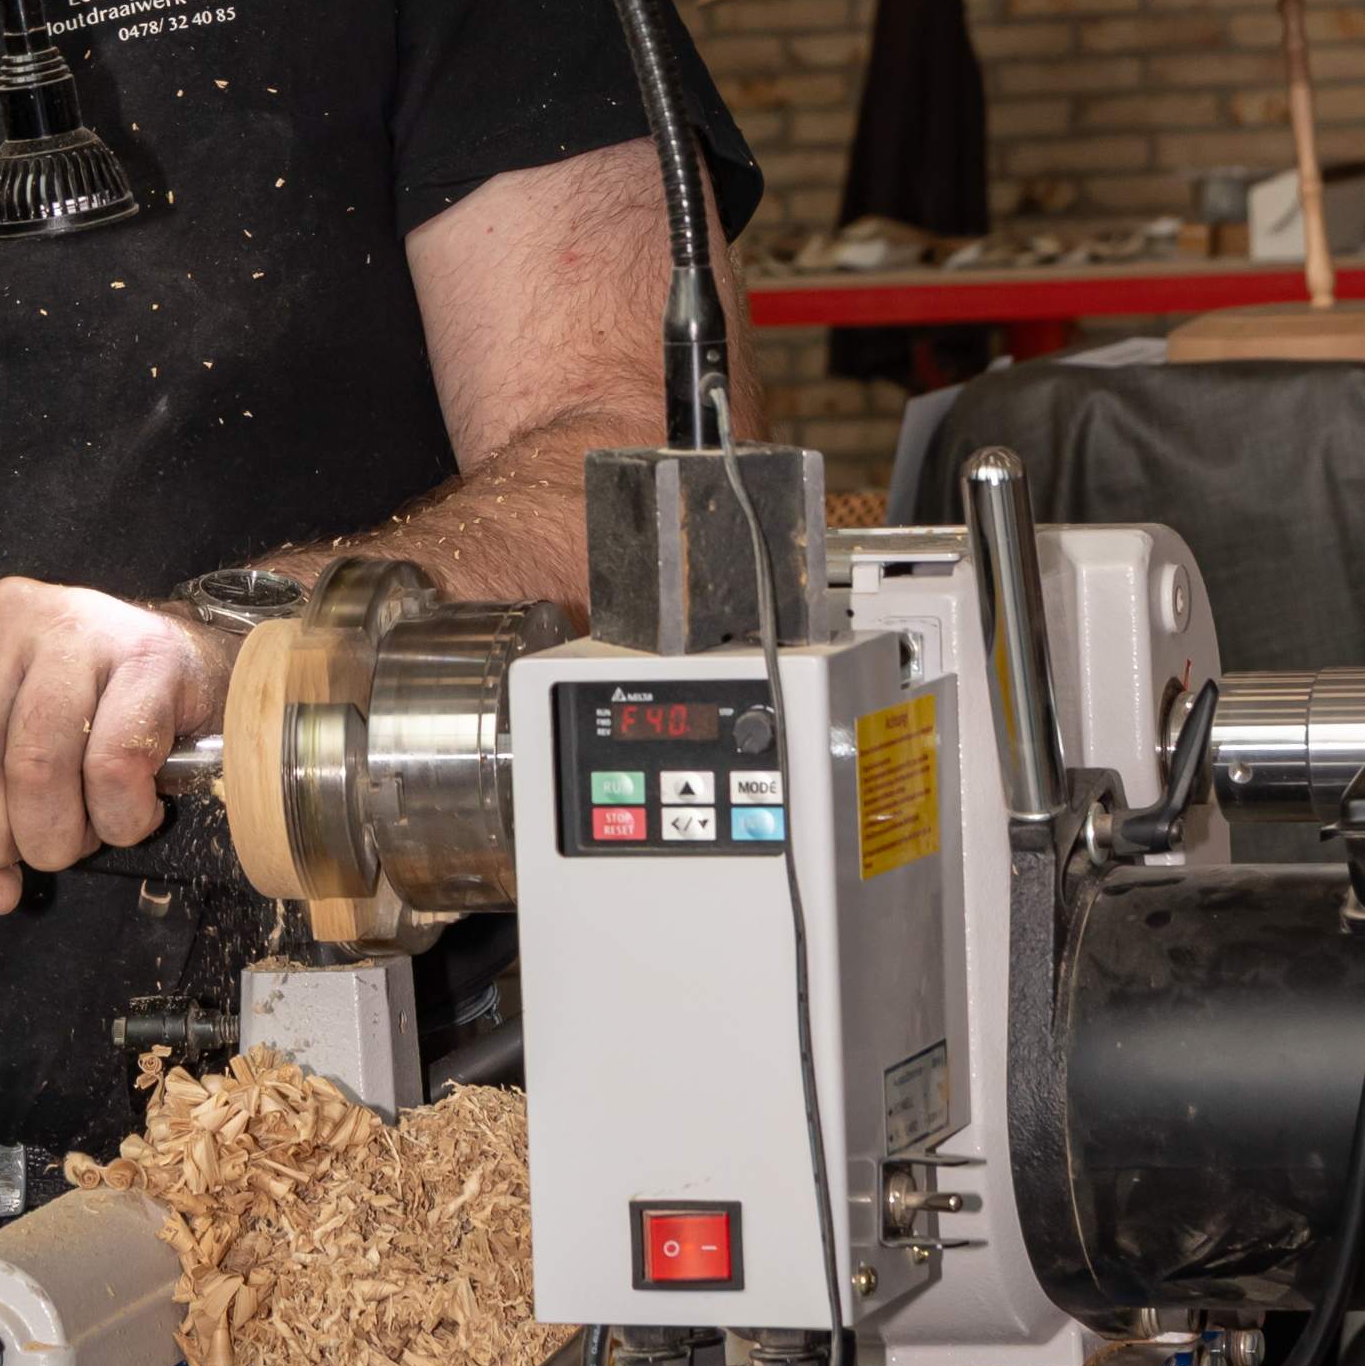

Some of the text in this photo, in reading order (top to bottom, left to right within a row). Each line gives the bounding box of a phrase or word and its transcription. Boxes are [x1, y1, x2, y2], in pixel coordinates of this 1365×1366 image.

[118, 7, 237, 42] 0478/ 32 40 85
[738, 780, 777, 794] MODE
[605, 812, 631, 823] STOP
[603, 825, 634, 835] RESET
